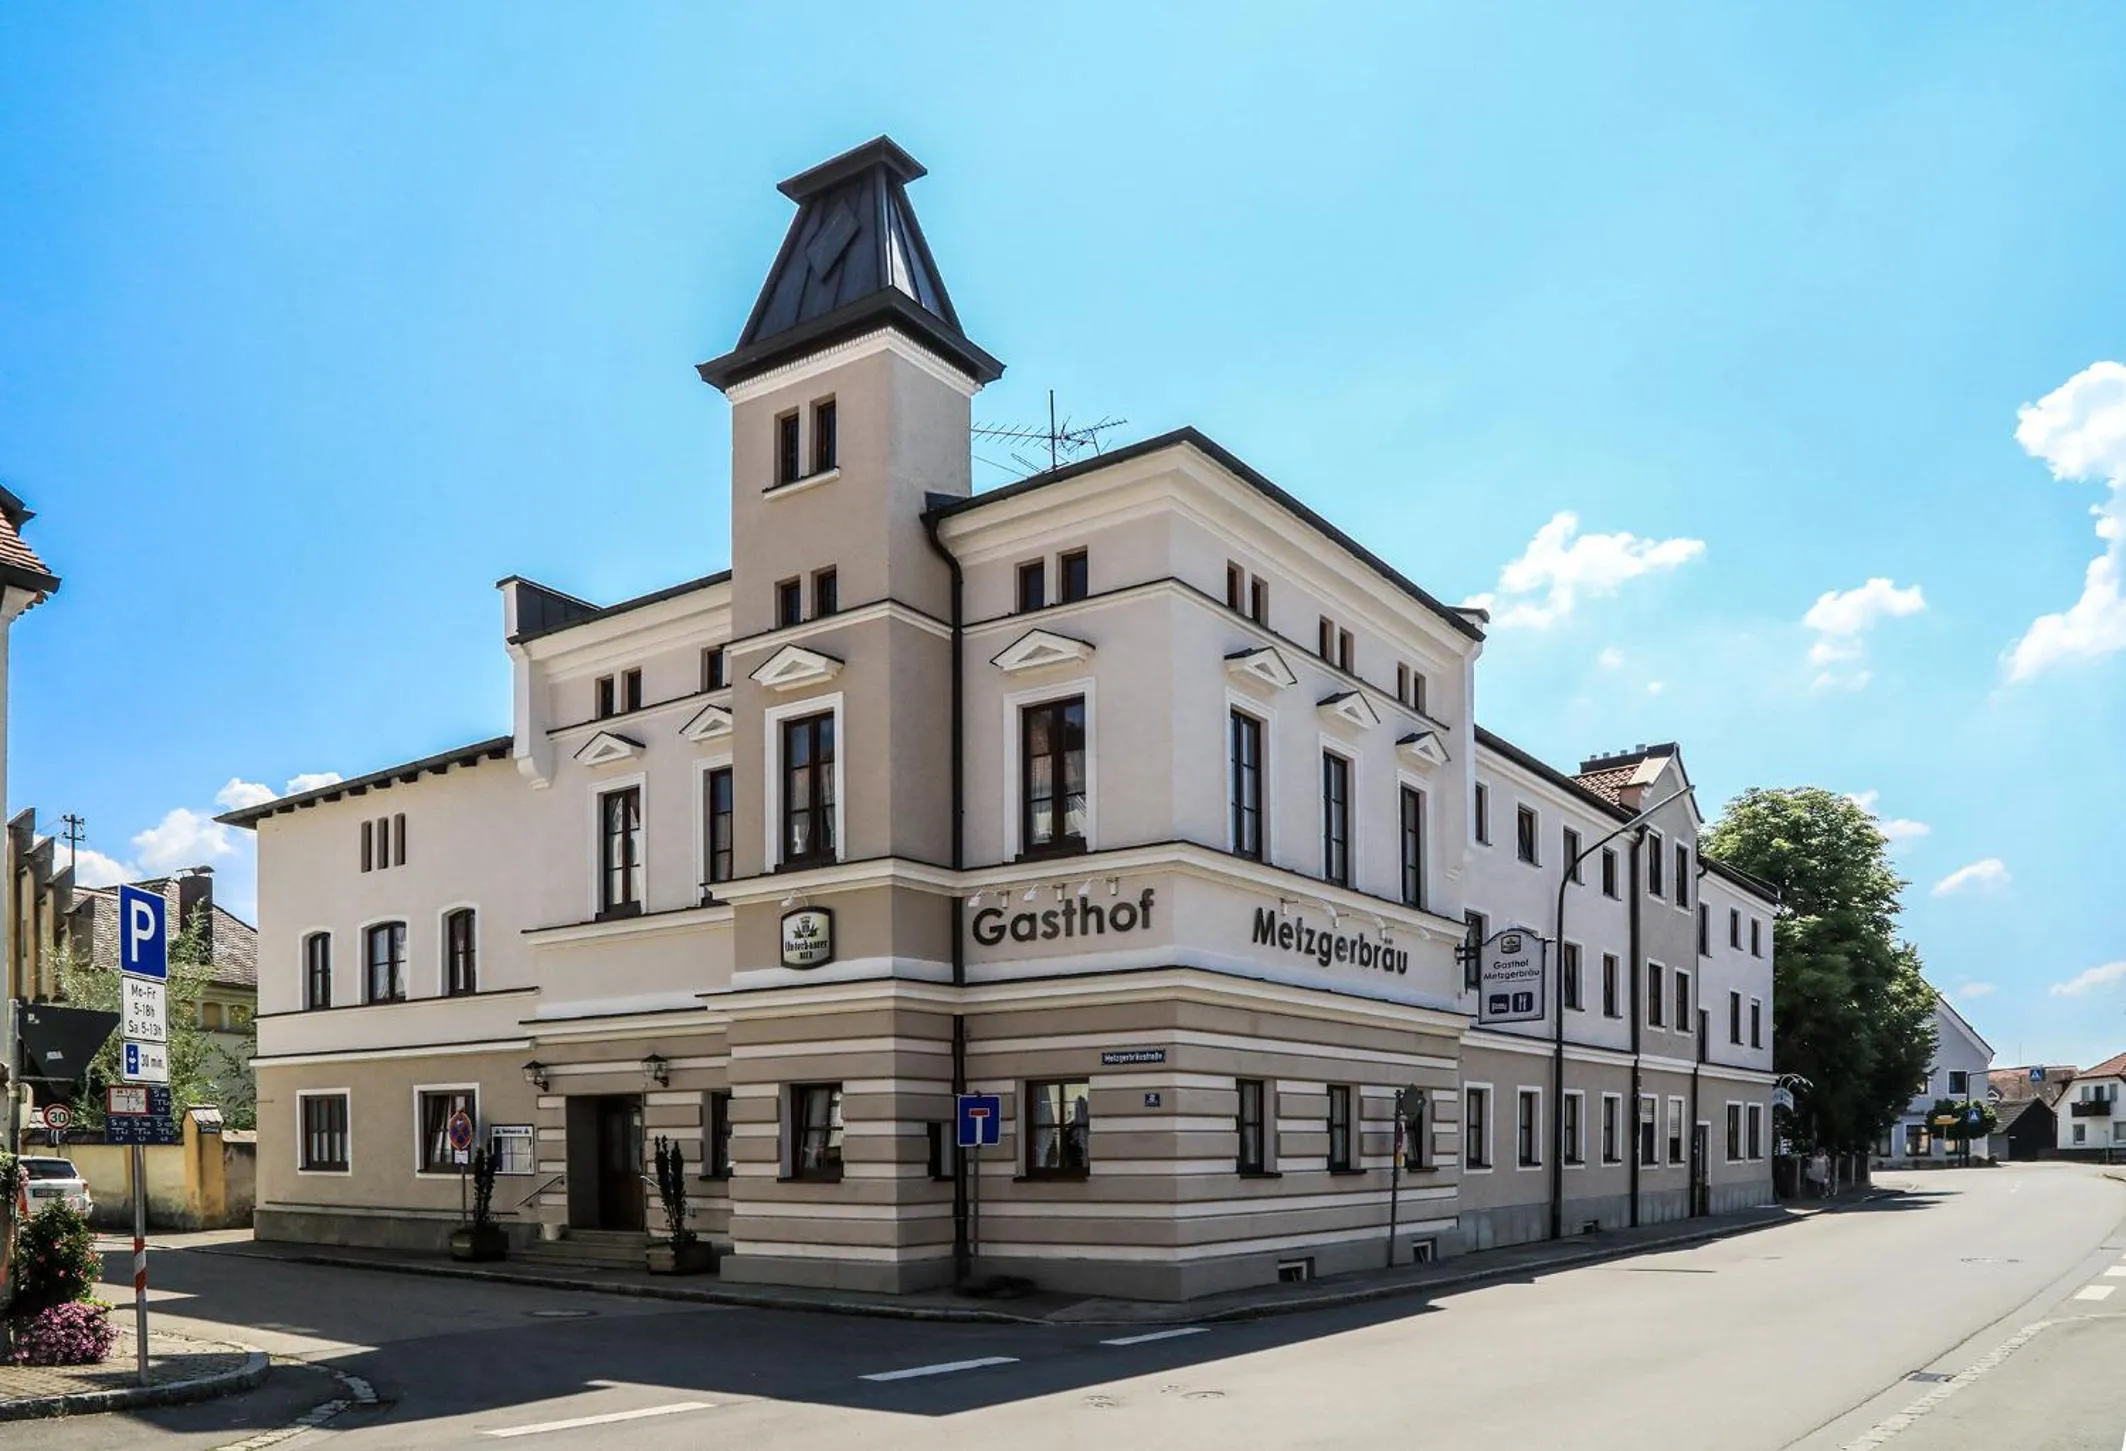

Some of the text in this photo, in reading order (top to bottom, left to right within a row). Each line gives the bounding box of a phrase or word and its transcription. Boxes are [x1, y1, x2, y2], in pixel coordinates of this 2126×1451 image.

[972, 888, 1154, 946] Gasthof
[130, 899, 155, 963] P
[1252, 907, 1408, 975] Metzgerbräu
[1493, 960, 1529, 970] Gasthof
[1483, 969, 1540, 980] Metzgerbräu
[131, 984, 156, 999] Mo-Fr
[128, 1020, 138, 1033] Sa
[50, 1111, 66, 1123] 30
